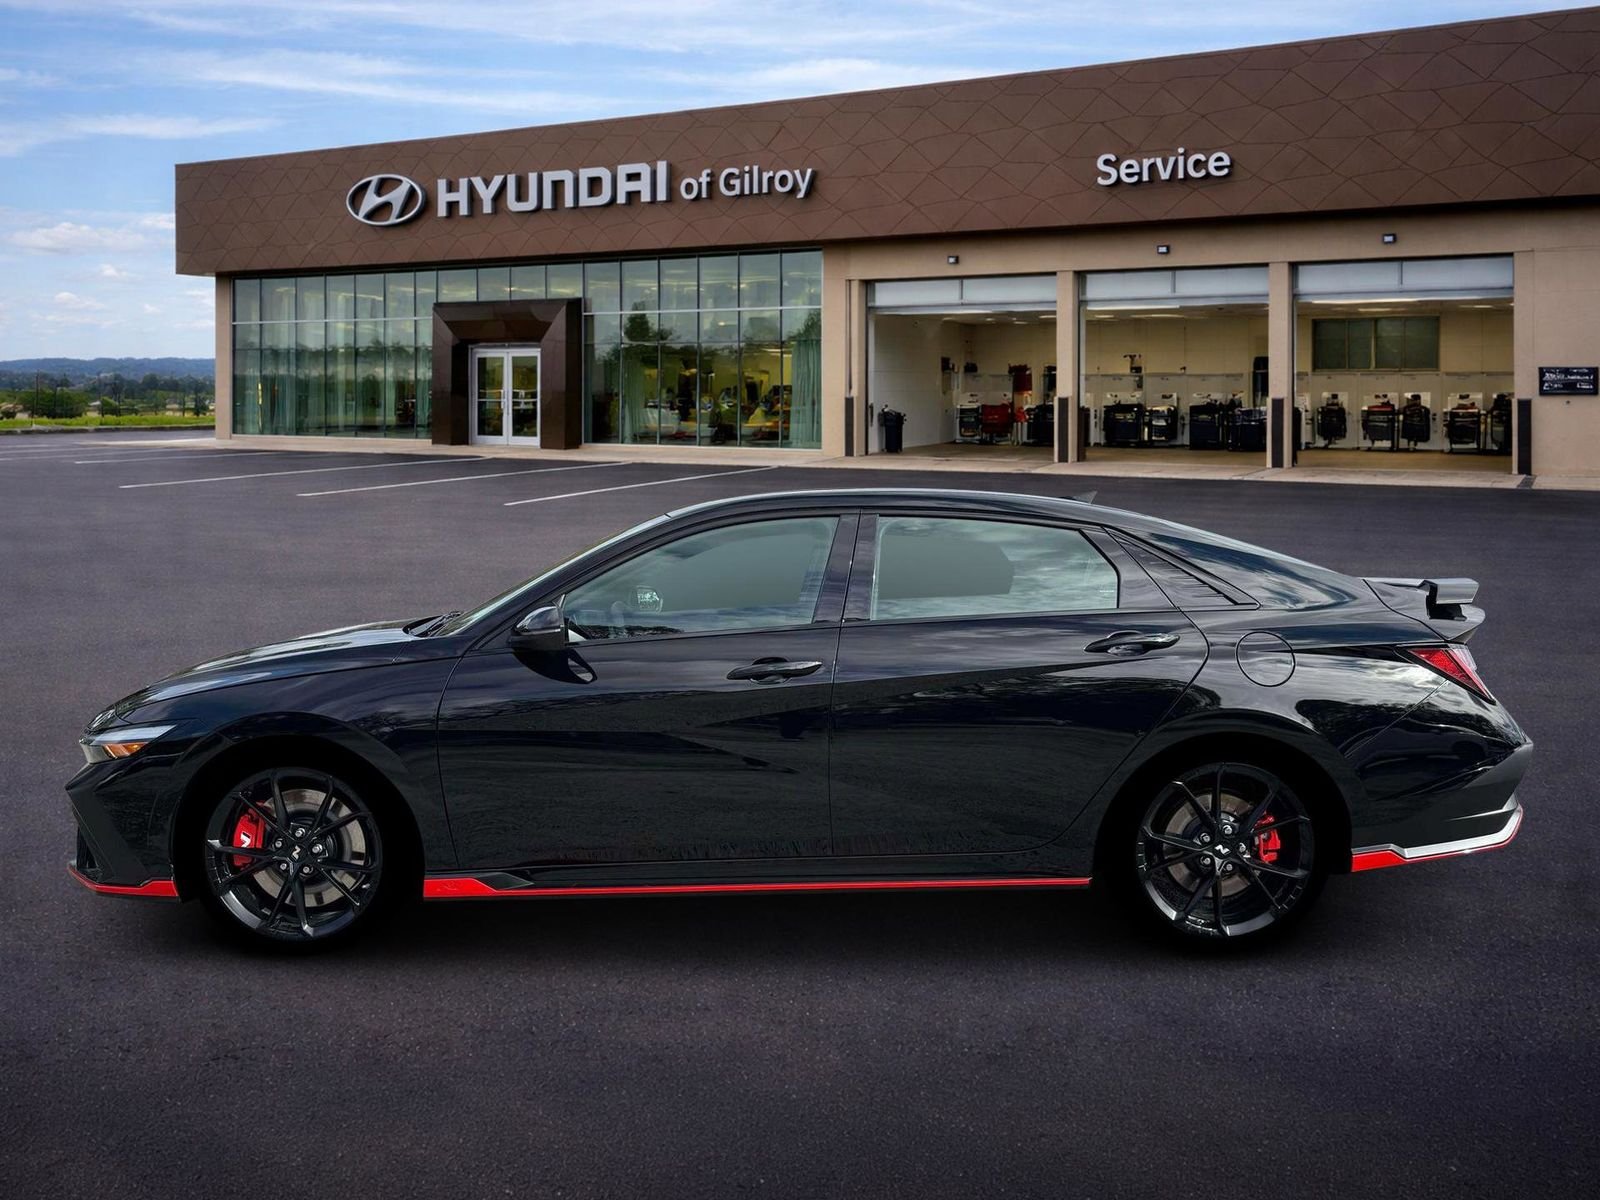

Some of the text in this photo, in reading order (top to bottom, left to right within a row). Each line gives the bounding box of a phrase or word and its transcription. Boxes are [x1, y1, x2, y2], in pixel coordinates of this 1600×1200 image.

[437, 160, 670, 217] HYUNDAI
[680, 168, 713, 200] of
[718, 165, 815, 198] Gilroy
[1096, 147, 1231, 186] Service
